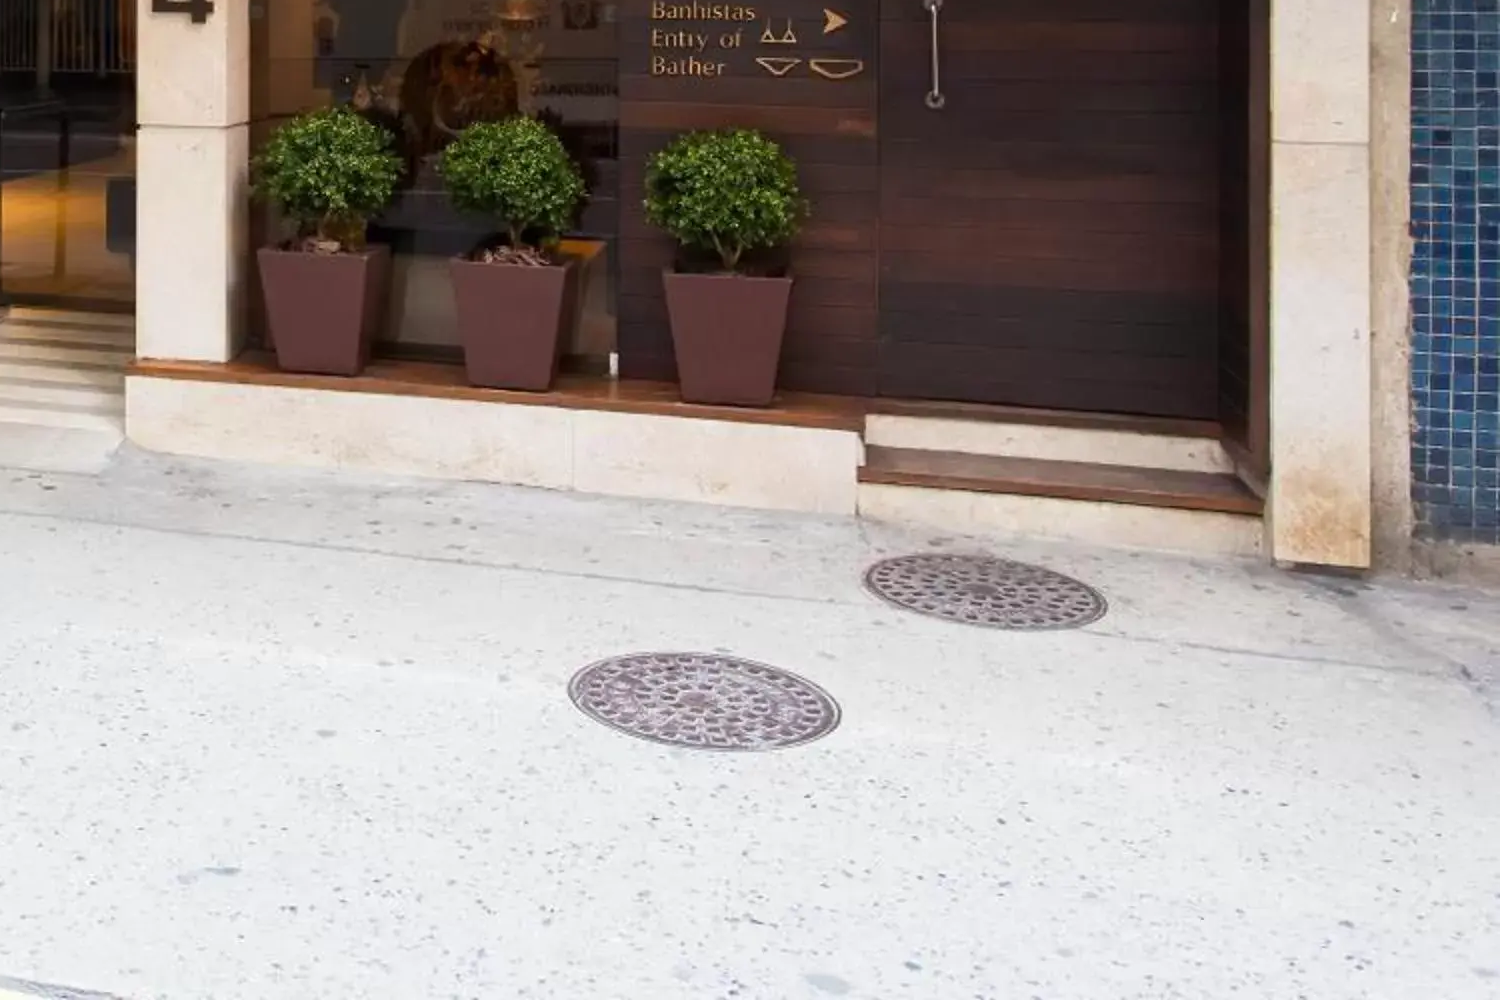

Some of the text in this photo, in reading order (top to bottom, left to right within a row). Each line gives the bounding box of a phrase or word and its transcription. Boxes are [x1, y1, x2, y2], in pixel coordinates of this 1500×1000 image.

[651, 0, 757, 21] Banhistas
[651, 28, 744, 52] Entry of
[652, 56, 725, 76] Bather
